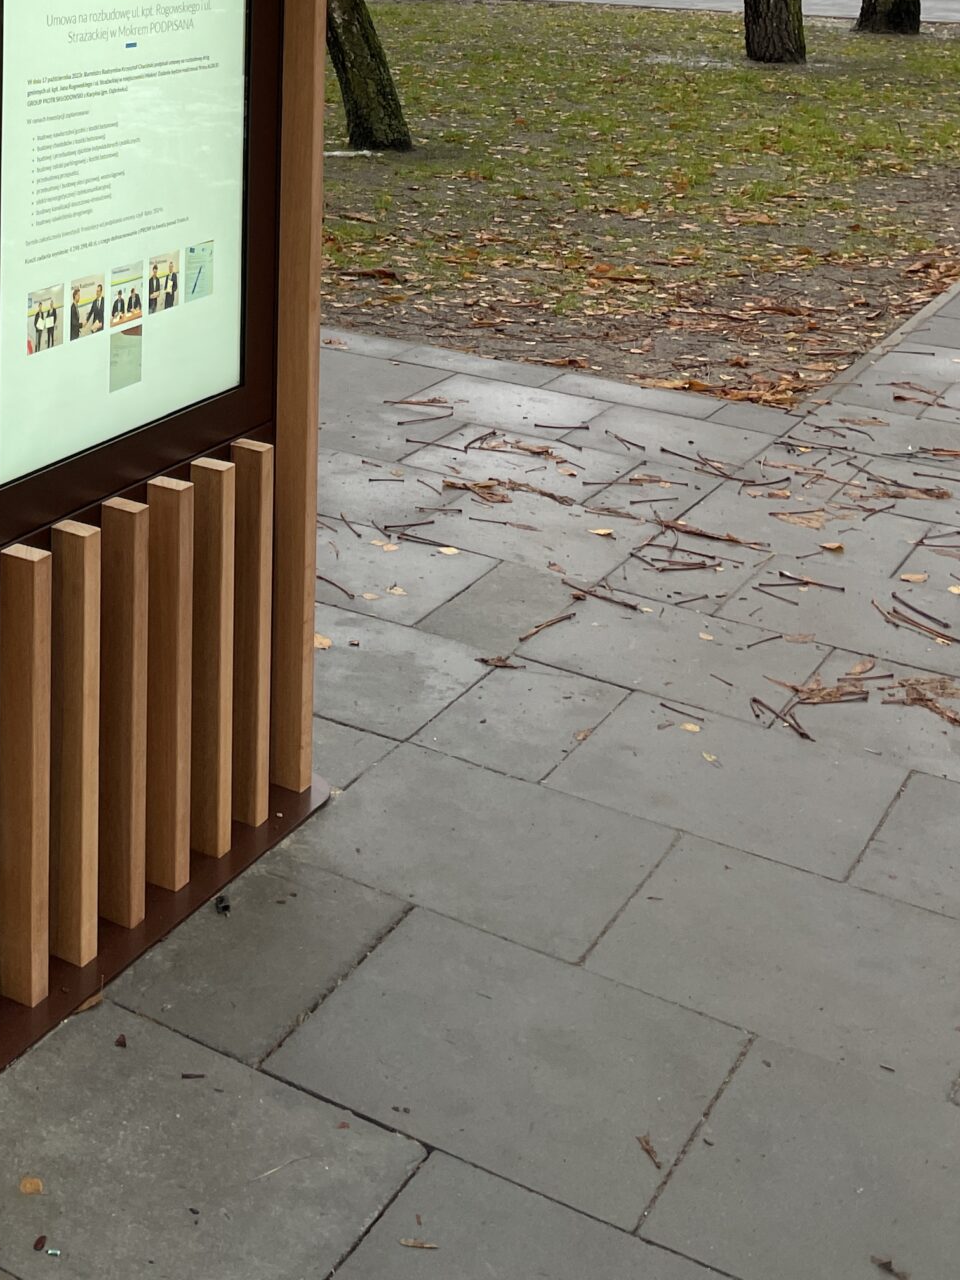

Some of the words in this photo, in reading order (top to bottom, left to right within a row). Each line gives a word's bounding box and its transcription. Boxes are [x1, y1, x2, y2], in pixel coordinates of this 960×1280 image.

[47, 12, 76, 27] Umowa
[79, 14, 87, 24] na
[89, 6, 131, 26] rozbudowę
[156, 0, 200, 19] Rogowskiego
[111, 30, 116, 39] w
[119, 23, 148, 38] Mokrem
[151, 18, 194, 34] PODPISANA
